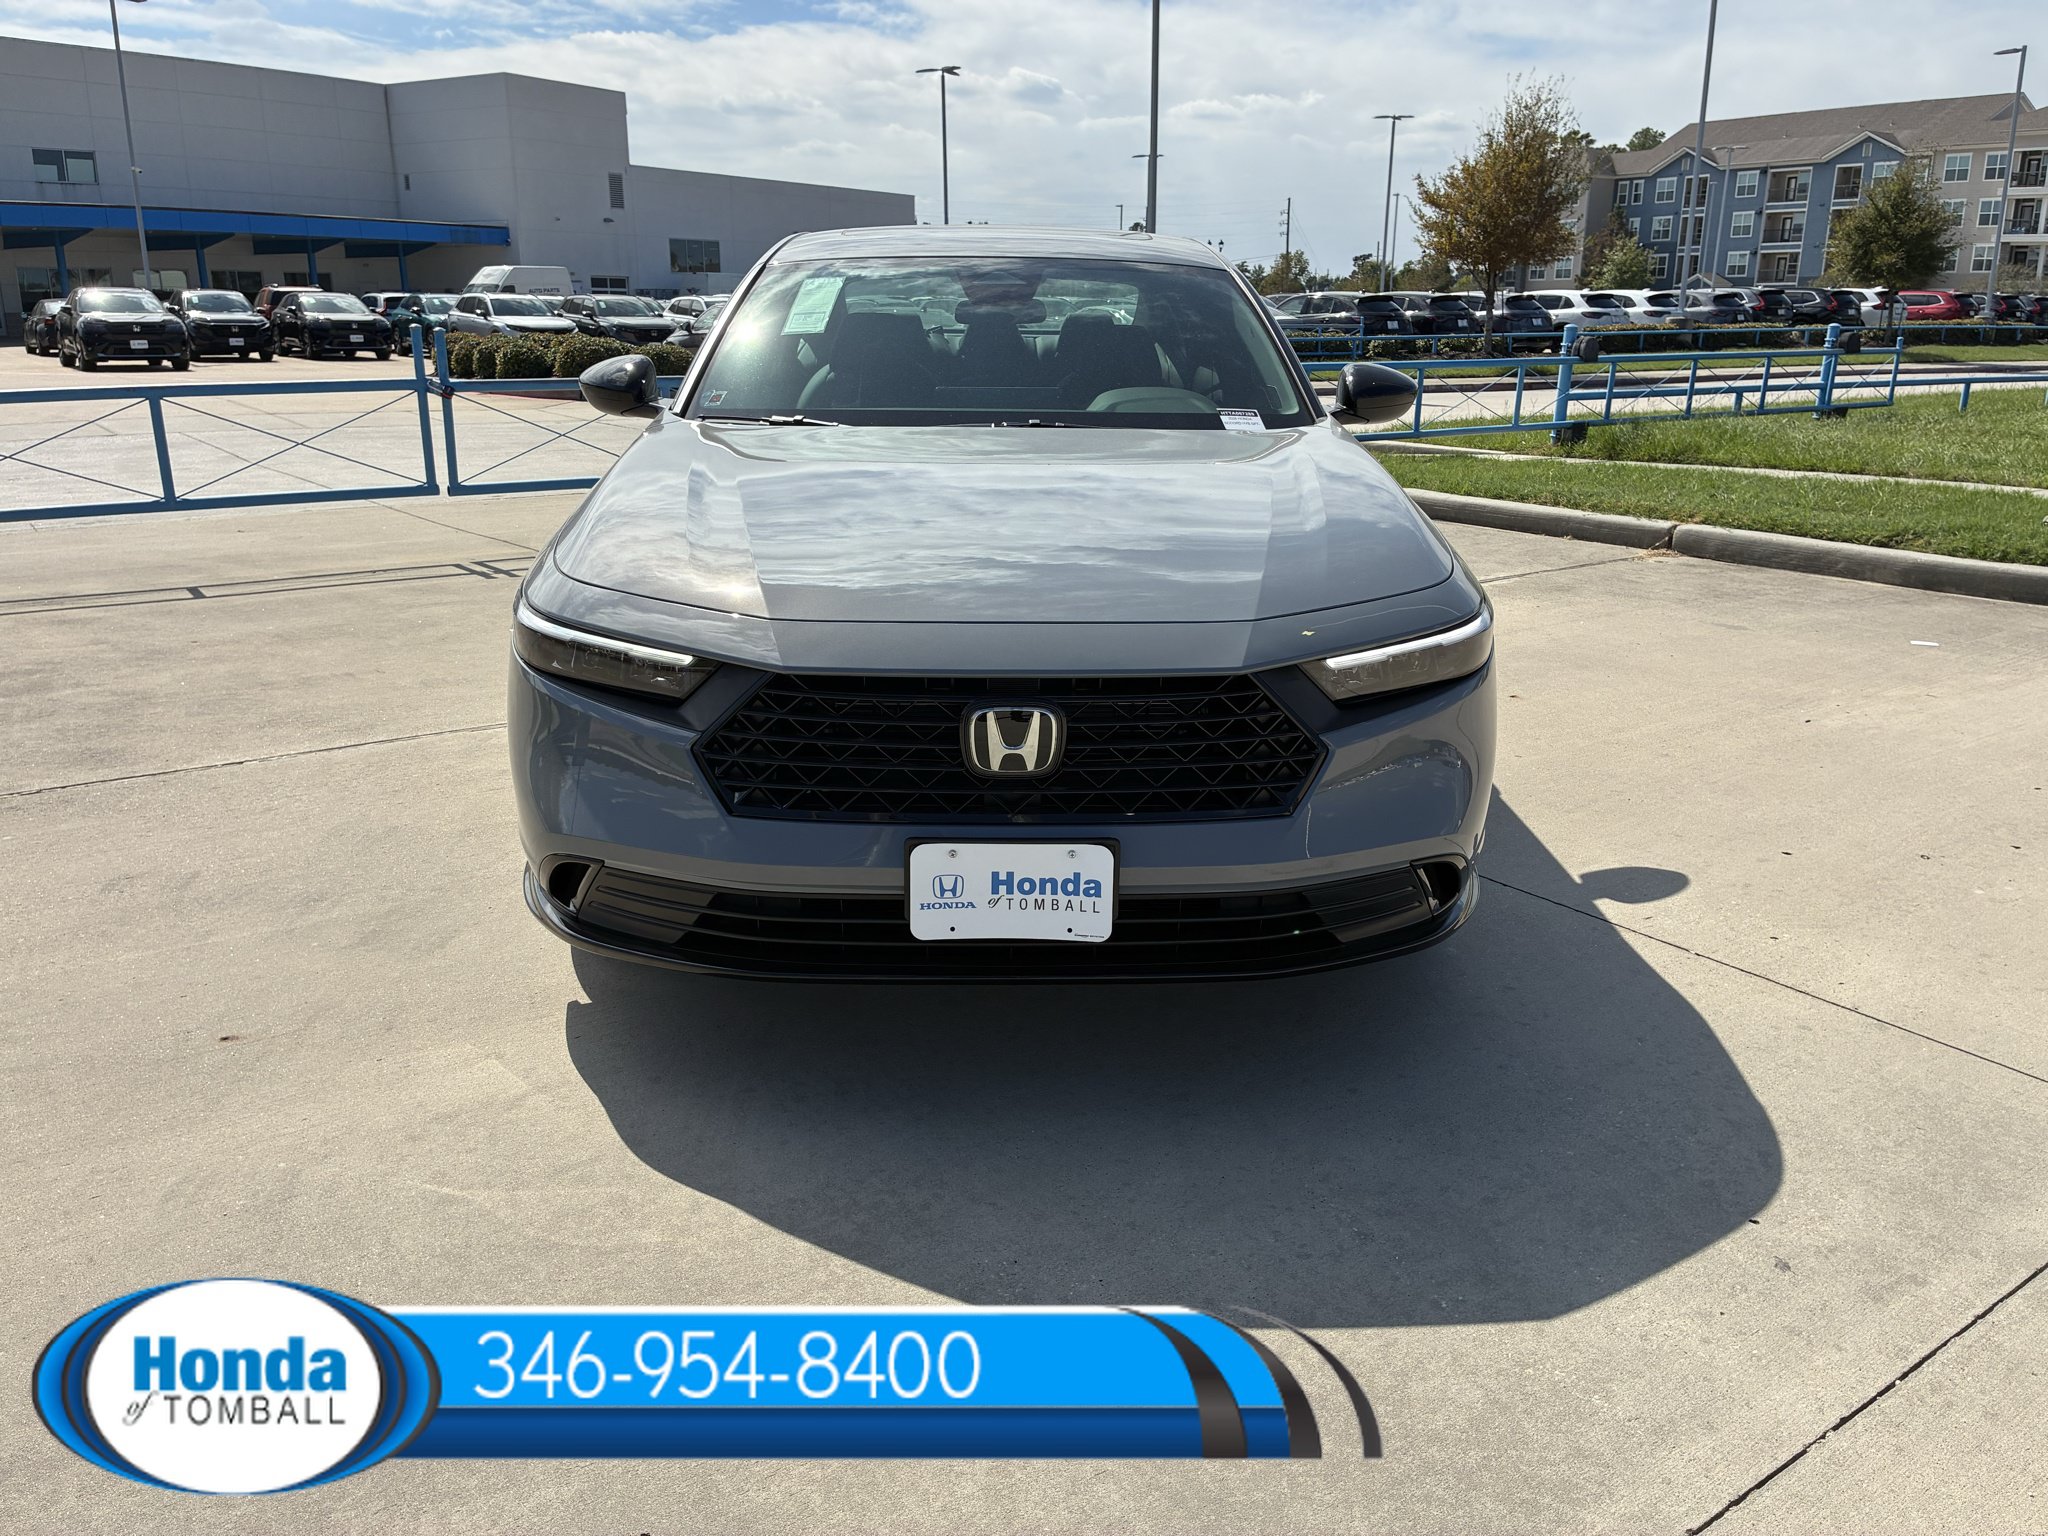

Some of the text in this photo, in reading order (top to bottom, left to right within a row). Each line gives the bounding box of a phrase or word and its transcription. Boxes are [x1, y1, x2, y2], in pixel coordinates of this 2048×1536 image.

[991, 871, 1102, 898] Honda
[919, 901, 977, 910] HONDA
[987, 894, 1101, 913] of TOMBALL
